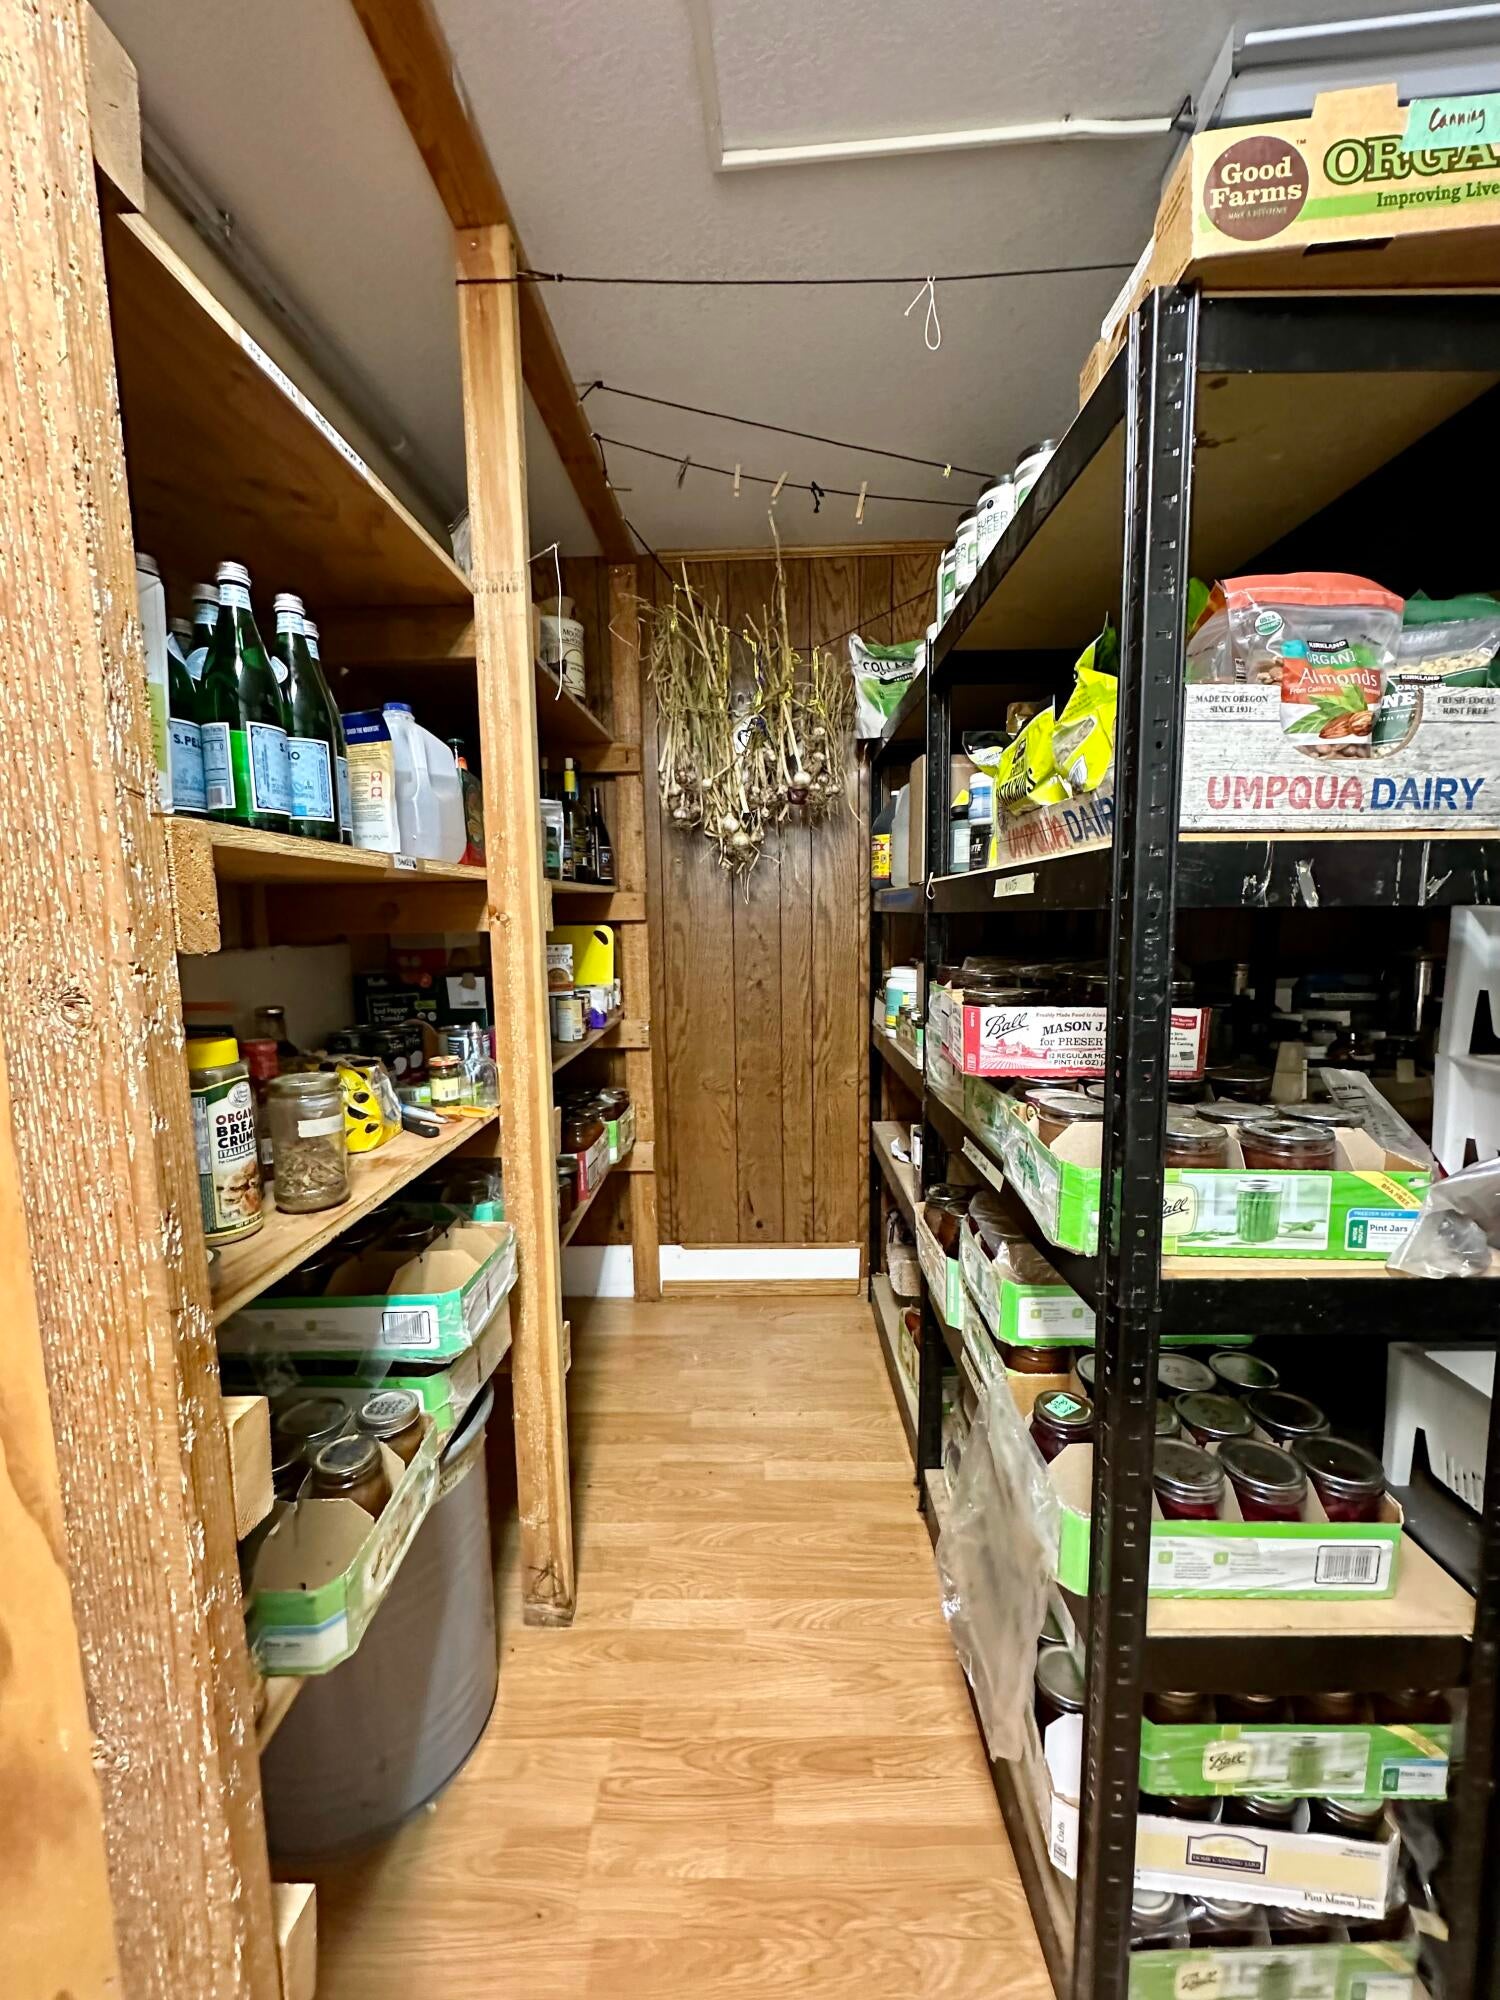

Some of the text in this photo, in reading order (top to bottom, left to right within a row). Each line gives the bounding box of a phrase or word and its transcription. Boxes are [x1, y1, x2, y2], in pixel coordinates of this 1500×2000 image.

[1429, 107, 1485, 133] Canning
[1221, 155, 1292, 185] Good
[1209, 184, 1302, 209] Farms
[1377, 185, 1461, 209] Improving
[1308, 640, 1347, 650] KIRKLAND
[1299, 668, 1377, 687] Almonds
[1196, 695, 1220, 703] MADE
[1232, 695, 1268, 703] OREGON
[1210, 705, 1234, 713] SINCE
[1466, 707, 1489, 715] FREE
[1207, 776, 1485, 811] UMPQUA DAIRY
[985, 1012, 1030, 1039] Ball
[1043, 1021, 1106, 1036] MASON J
[1040, 1037, 1106, 1046] for PRESER
[1370, 1224, 1408, 1232] Pint Jars
[1209, 1751, 1247, 1771] Ball
[1304, 1891, 1322, 1902] Pint
[1326, 1893, 1355, 1907] Mason
[1357, 1896, 1376, 1910] Jars
